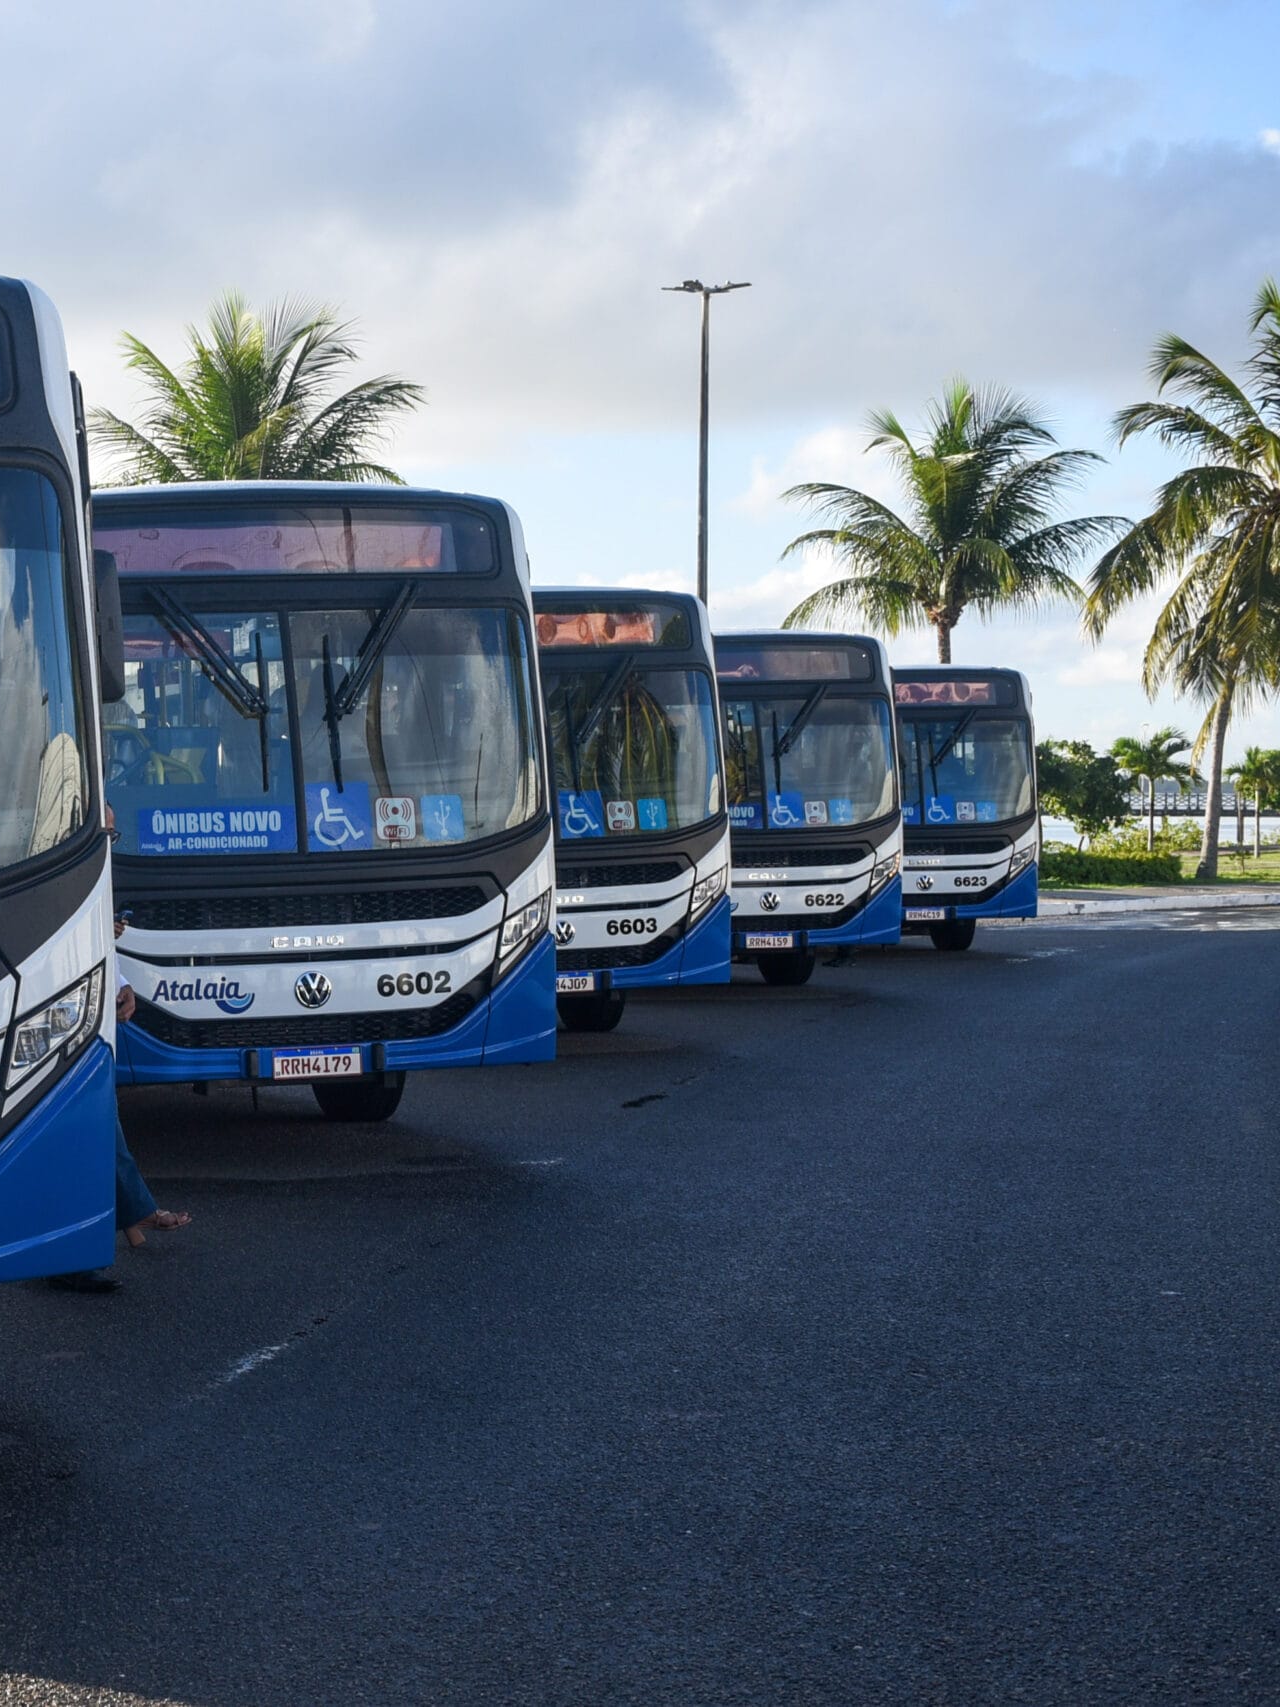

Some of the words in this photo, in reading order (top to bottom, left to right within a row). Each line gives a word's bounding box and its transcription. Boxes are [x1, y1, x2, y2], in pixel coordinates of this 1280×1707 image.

[151, 809, 225, 835] ÔNIBUS
[229, 810, 282, 833] NOVO
[168, 835, 268, 850] AR-CONDICIONADO
[954, 876, 987, 887] 6623
[805, 893, 845, 907] 6622
[606, 917, 658, 936] 6603
[152, 976, 248, 1002] Atalaia
[377, 970, 452, 998] 6602
